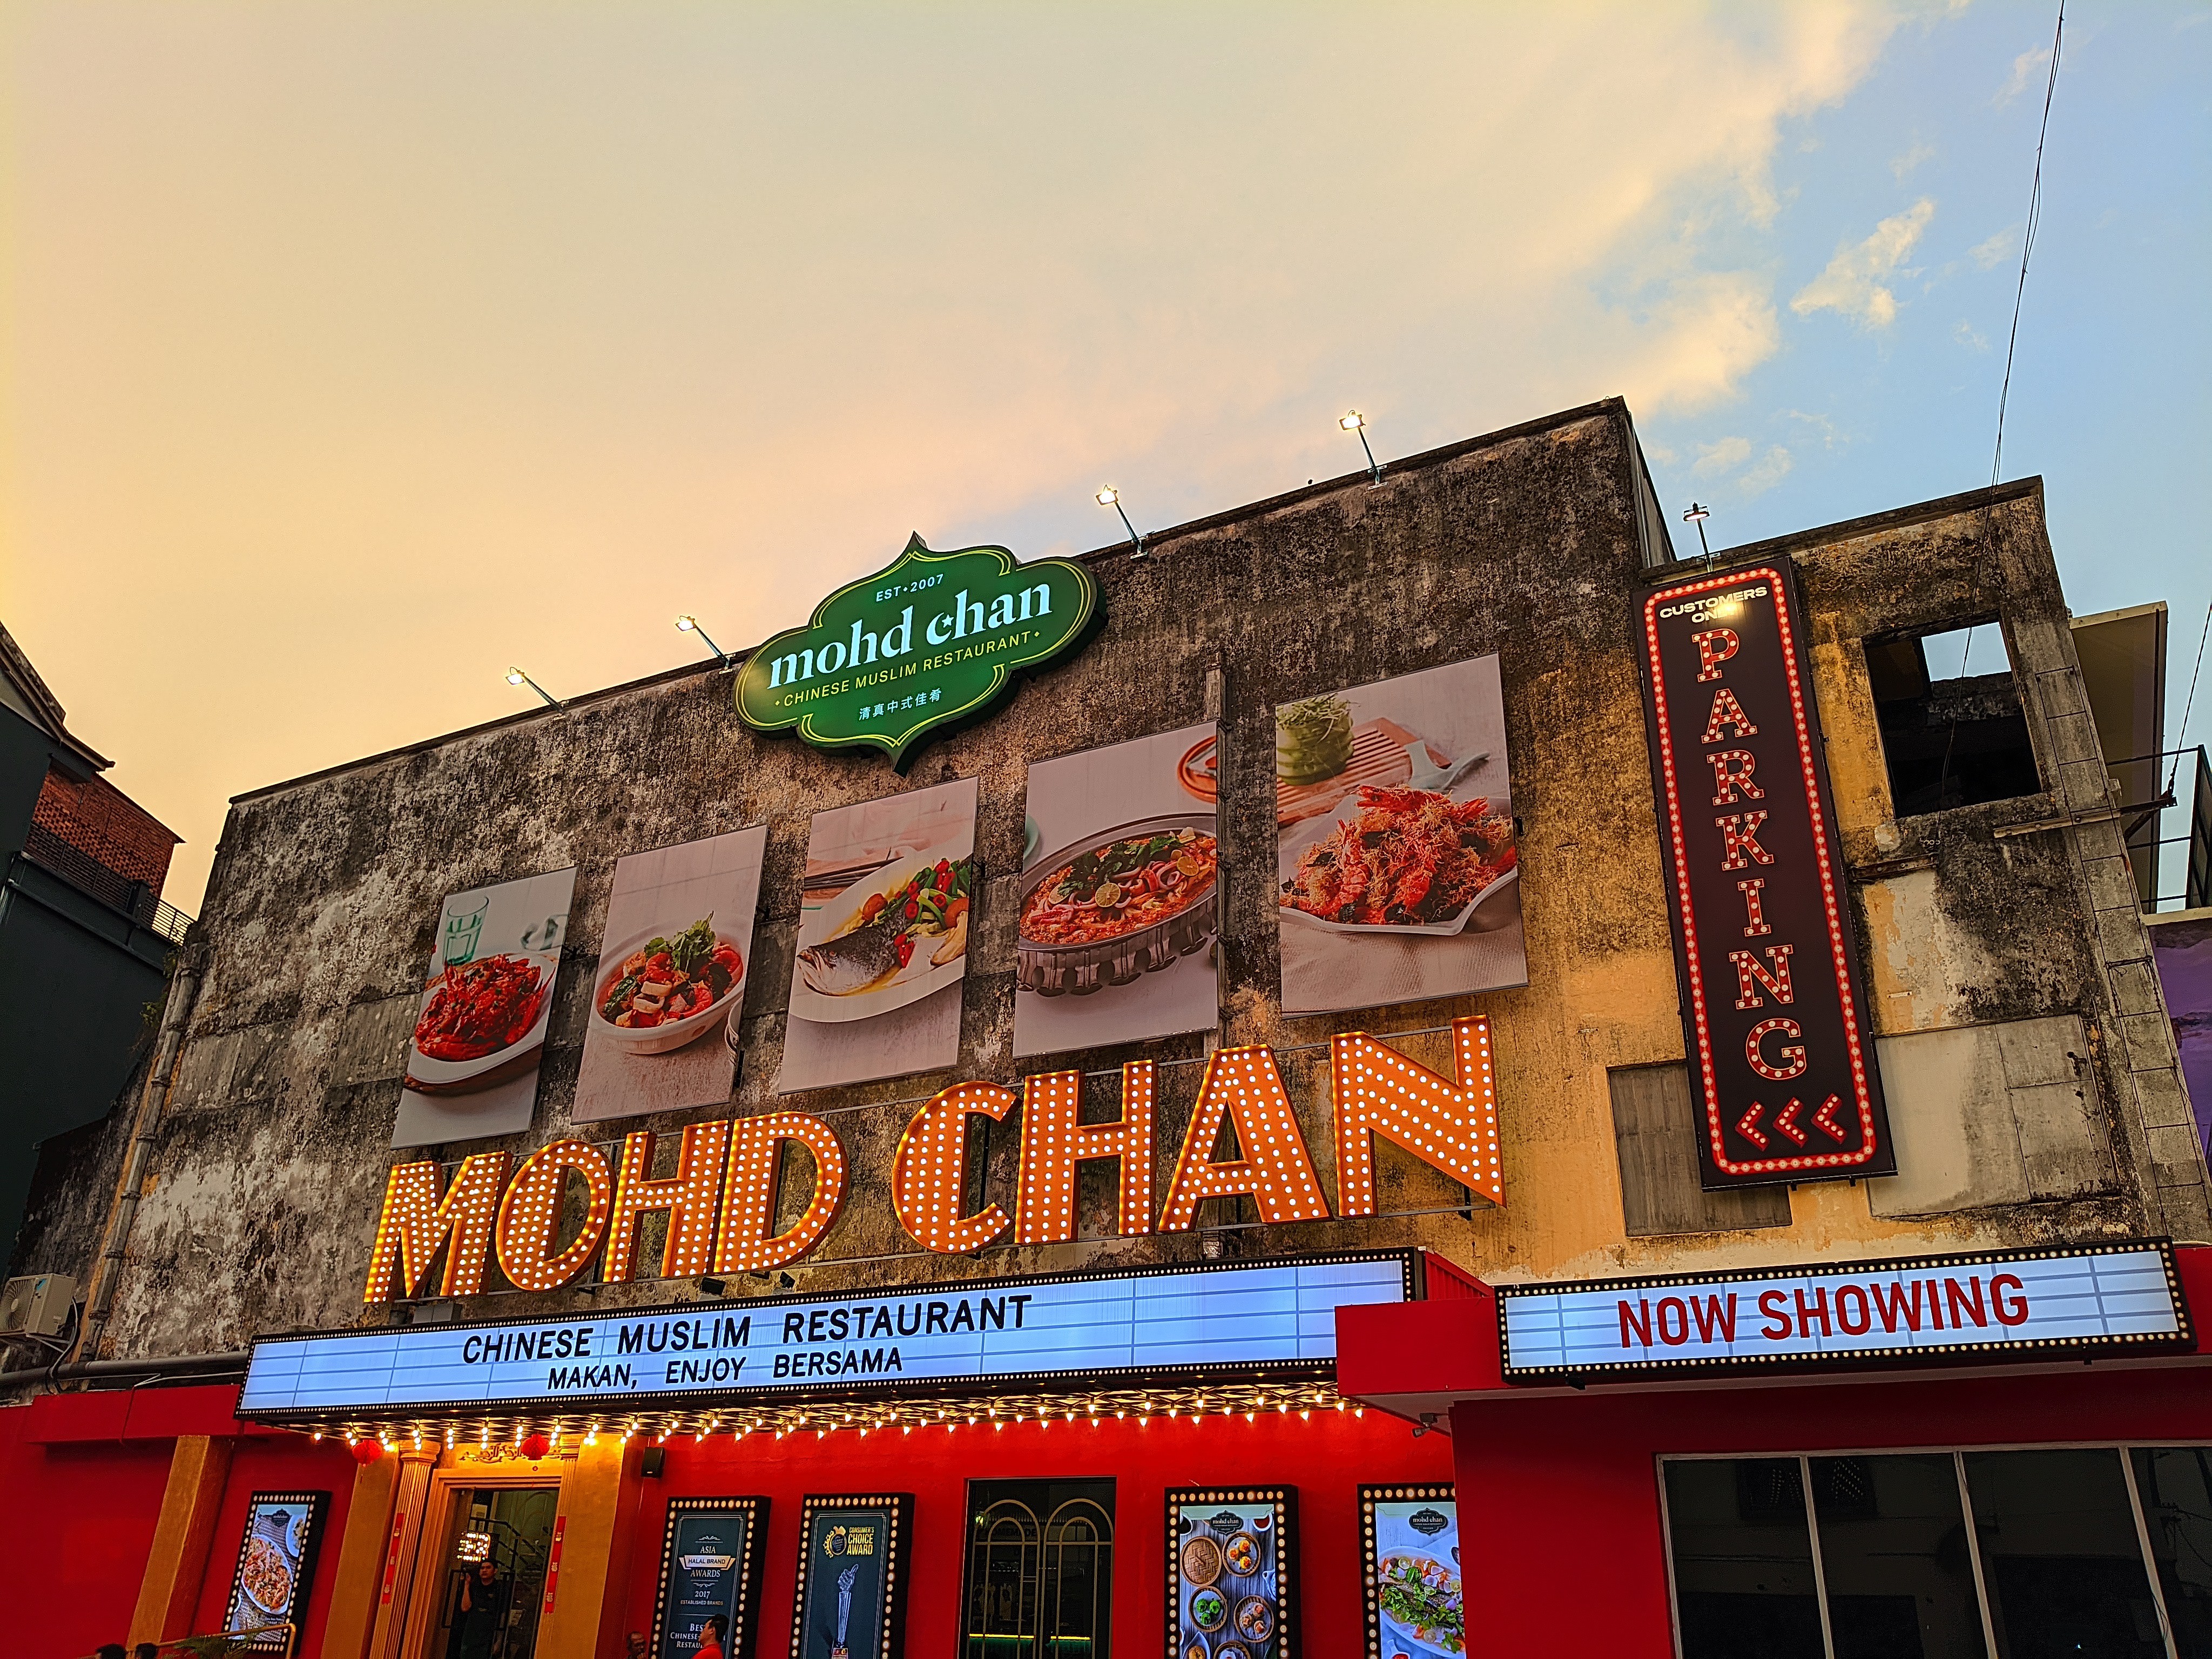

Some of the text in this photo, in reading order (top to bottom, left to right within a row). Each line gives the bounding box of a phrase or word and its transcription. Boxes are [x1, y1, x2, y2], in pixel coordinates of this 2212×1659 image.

[875, 574, 944, 602] EST 2007
[1659, 586, 1768, 618] CUSTOMERS
[767, 582, 1053, 690] mohd chan
[784, 631, 1030, 707] CHINESE MUSLIM RESTAURANT
[859, 687, 942, 721] 清真中式佳肴
[1691, 628, 1807, 1080] PARKING
[363, 1014, 1508, 1303] MOHD CHAN
[1617, 1273, 2029, 1349] NOW SHOWING
[462, 1294, 1033, 1364] CHINESE MUSLIM RESTAURANT
[547, 1346, 903, 1390] MAKAN, ENJOY BERSAMA
[700, 1546, 716, 1554] ASIA
[846, 1544, 873, 1555] AWARD
[848, 1533, 874, 1545] CHOICE
[690, 1569, 721, 1577] AWARDS
[694, 1590, 711, 1599] 2017
[689, 1623, 705, 1631] BES
[676, 1641, 704, 1649] RESTAU
